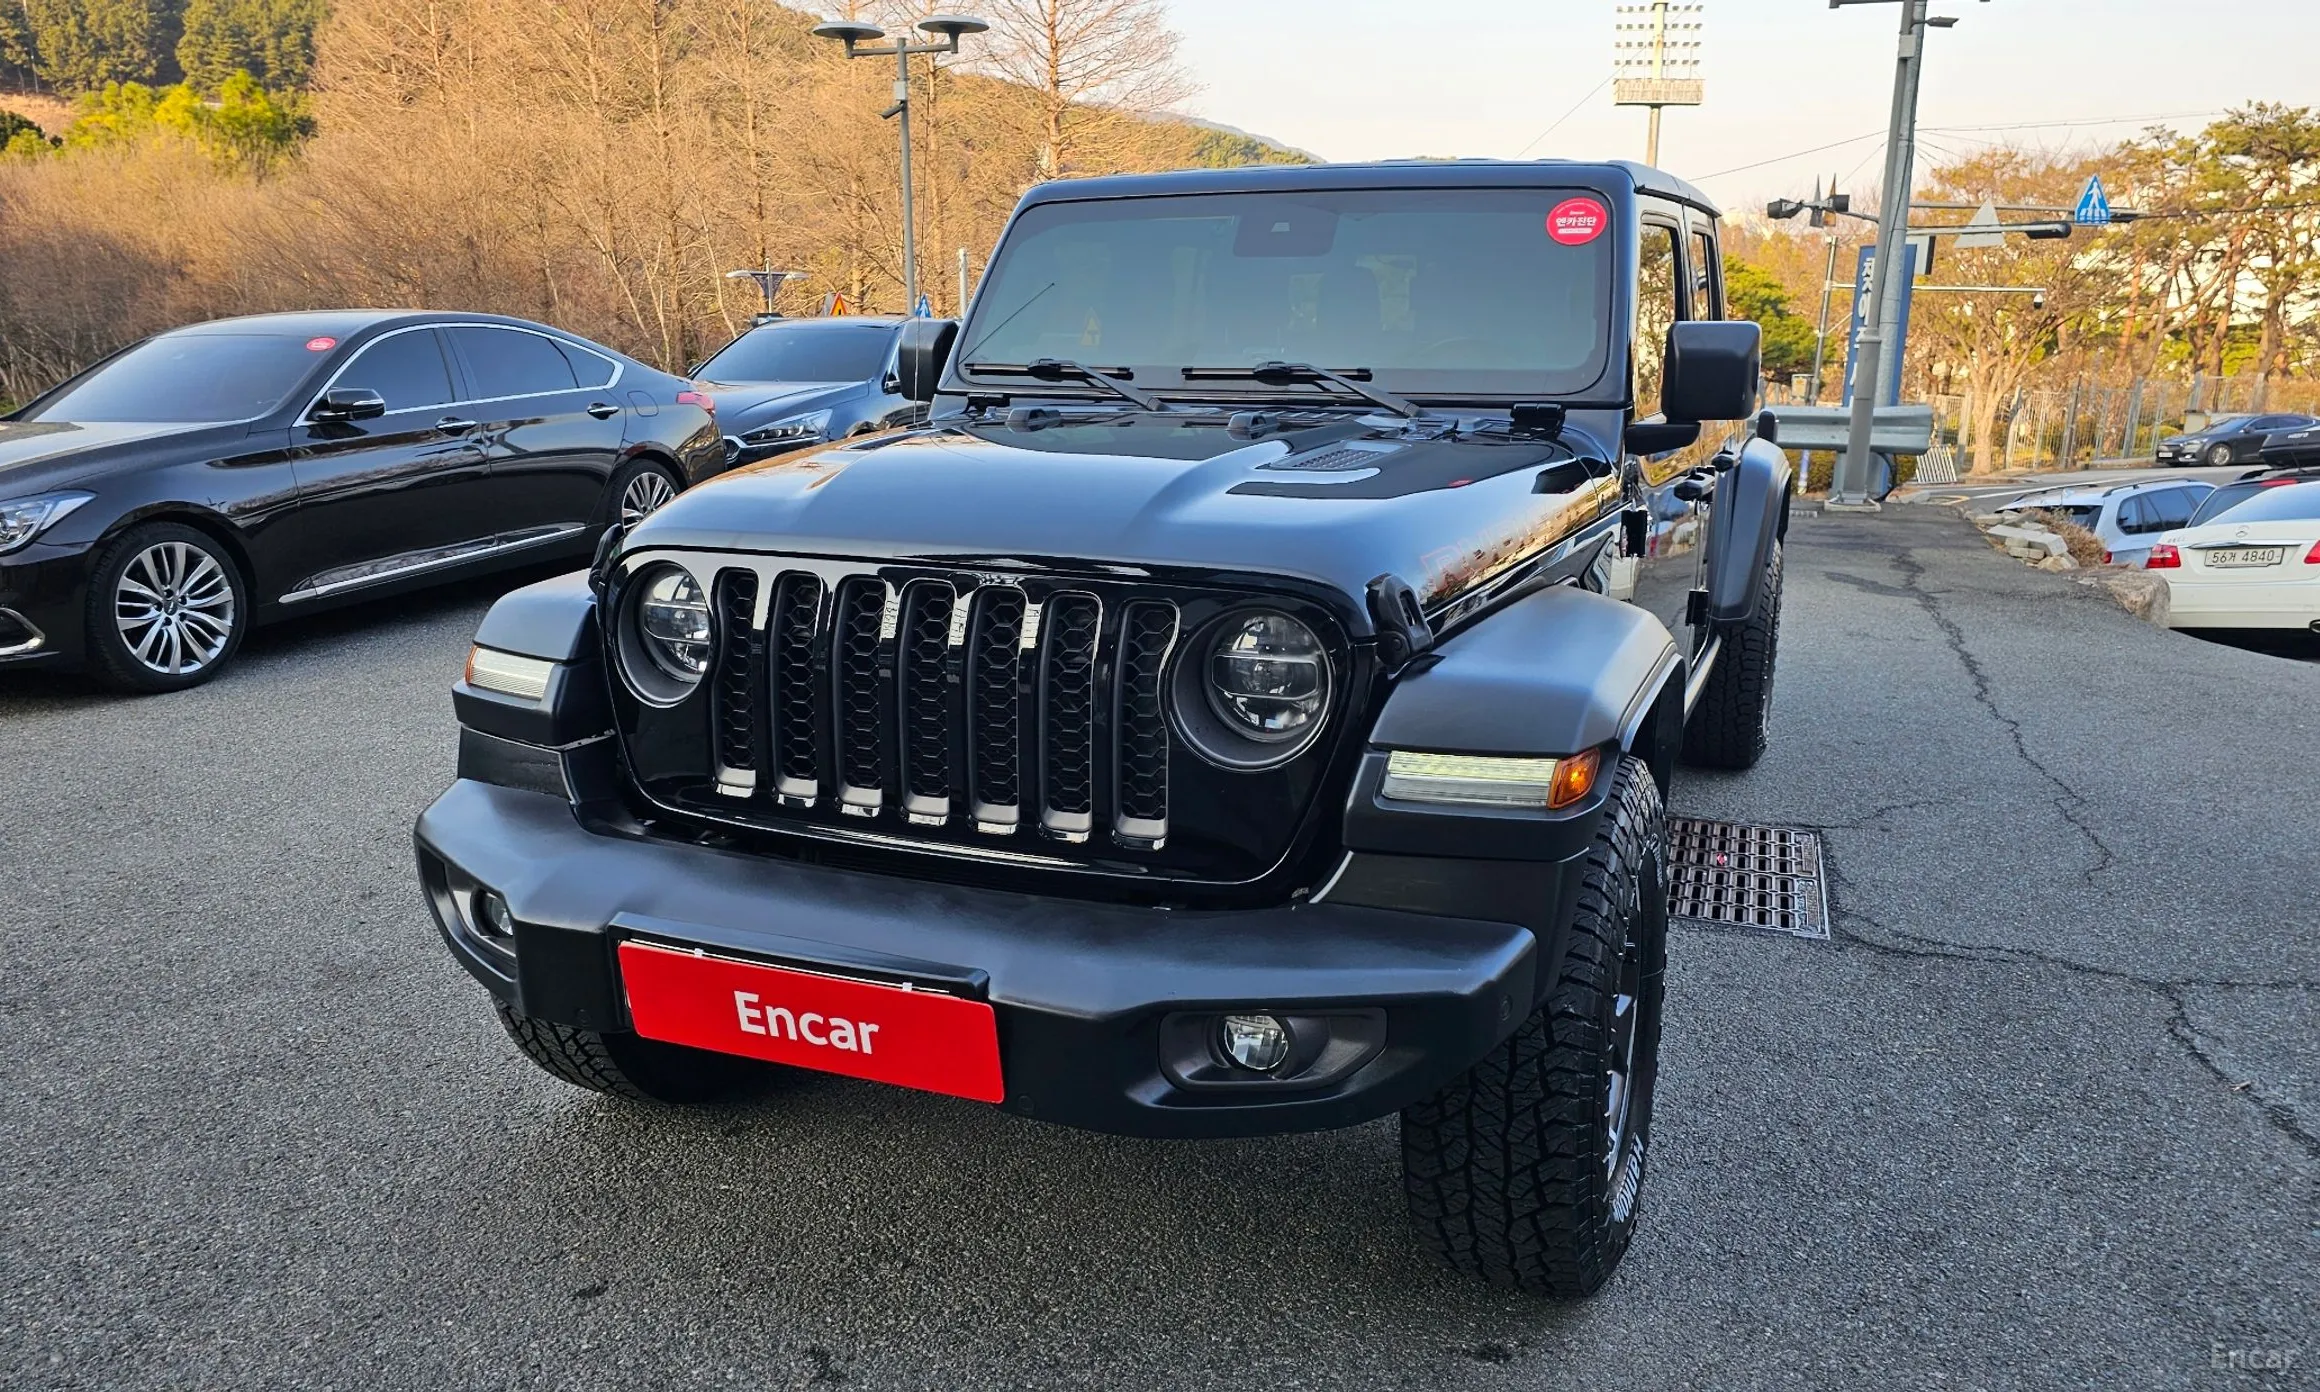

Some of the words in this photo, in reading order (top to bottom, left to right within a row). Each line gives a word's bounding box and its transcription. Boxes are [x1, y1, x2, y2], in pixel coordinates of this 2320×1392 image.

[1556, 216, 1597, 227] 엔카진단
[2241, 549, 2275, 562] 4840
[733, 990, 880, 1055] Encar
